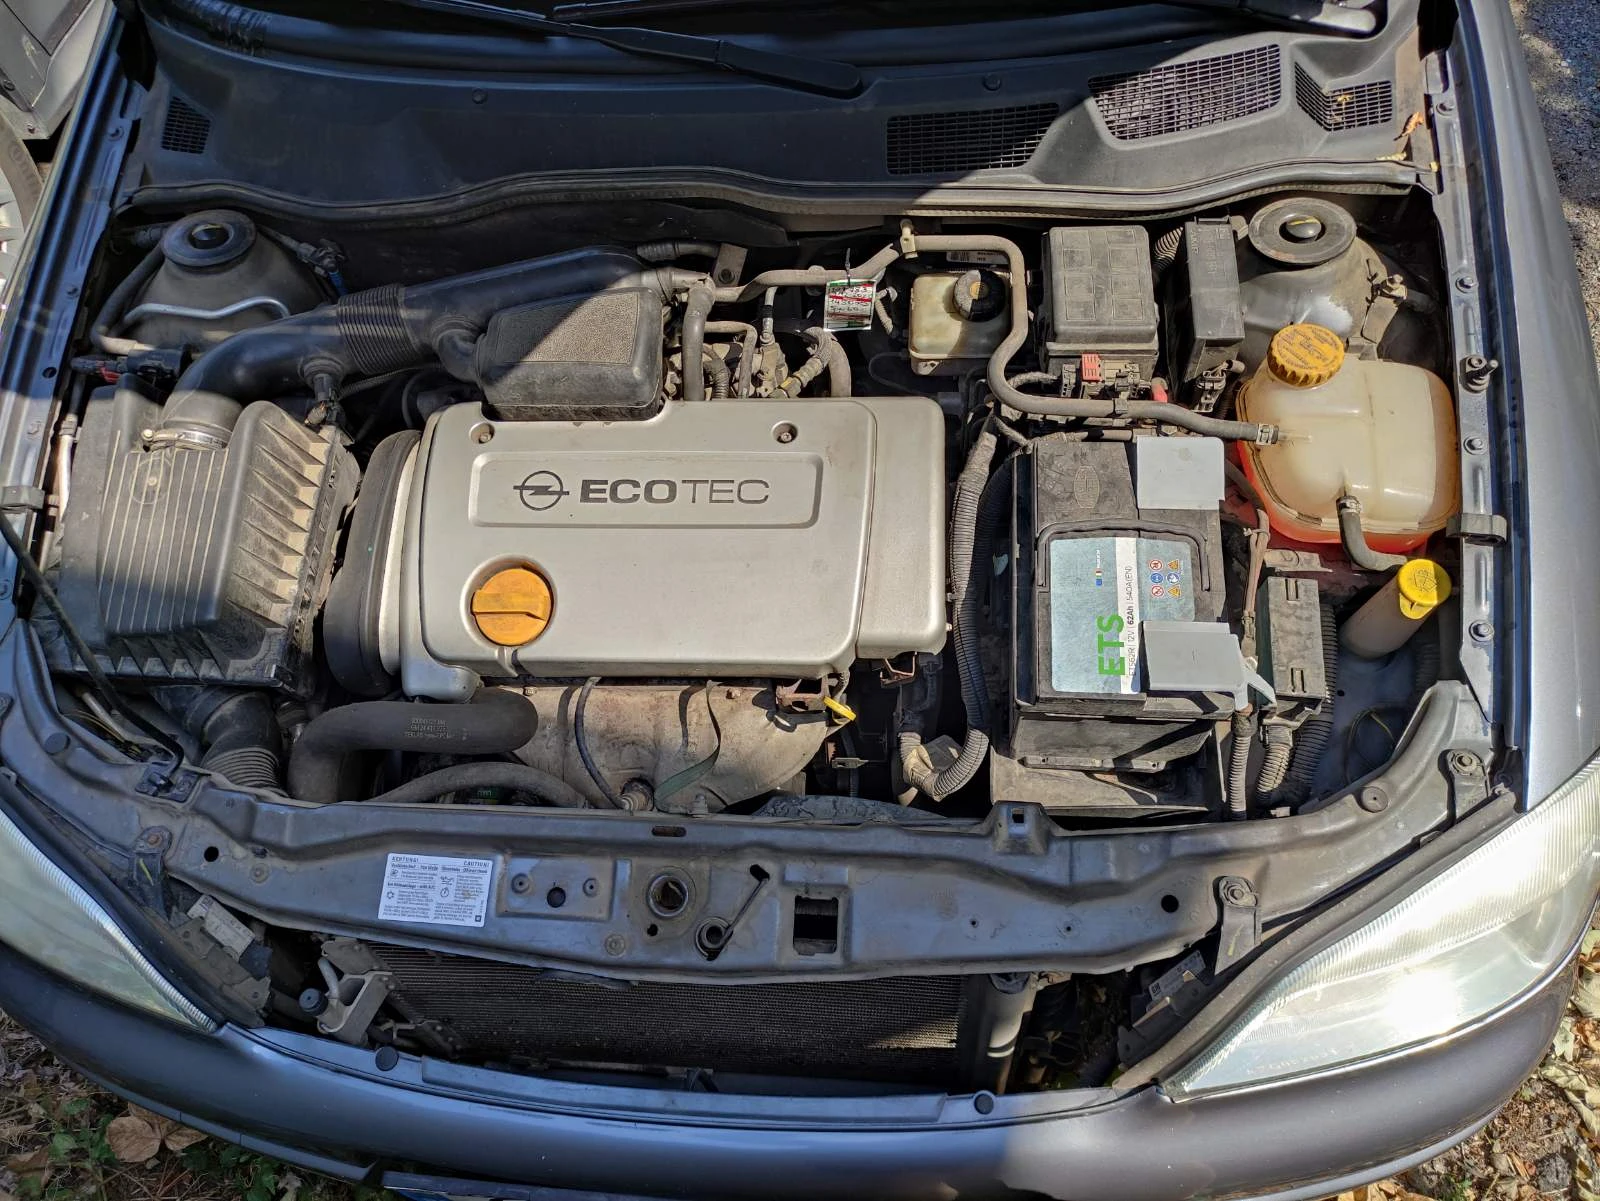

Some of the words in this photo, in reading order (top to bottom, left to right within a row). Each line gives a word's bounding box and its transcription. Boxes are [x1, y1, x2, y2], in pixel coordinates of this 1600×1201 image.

[579, 479, 770, 504] ECOTEC
[1126, 605, 1135, 625] 62Ah
[1097, 614, 1125, 676] ETS
[1127, 631, 1135, 643] 12V
